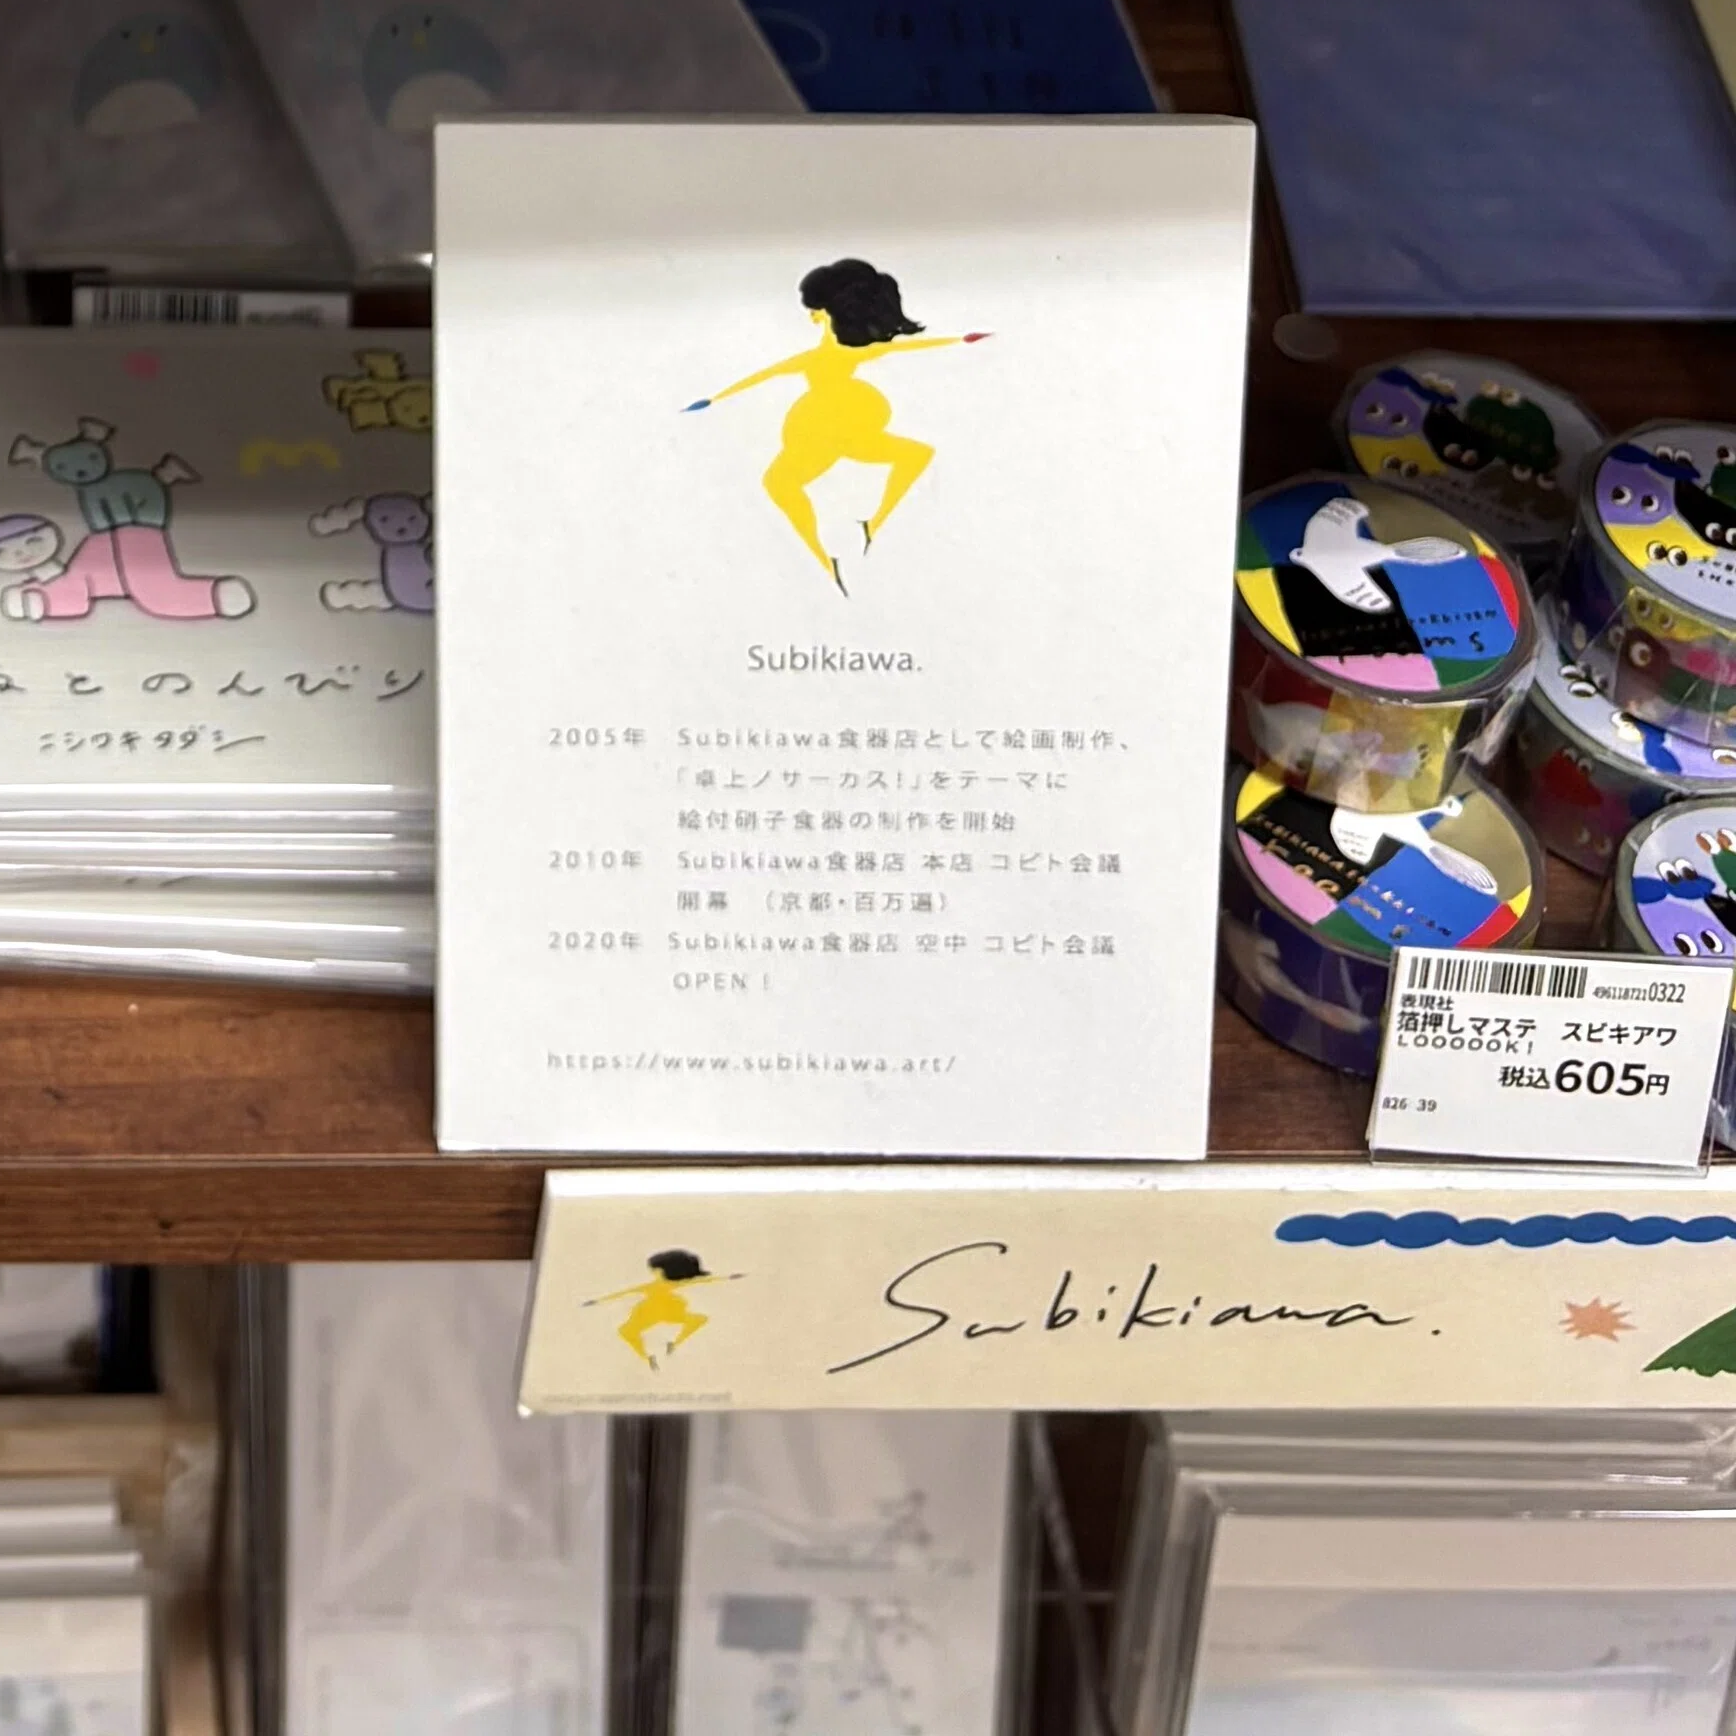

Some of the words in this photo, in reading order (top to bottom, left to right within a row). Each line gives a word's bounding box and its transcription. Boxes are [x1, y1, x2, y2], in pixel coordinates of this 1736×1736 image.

[746, 644, 924, 674] Subikiawa.
[548, 726, 646, 749] 2005年
[548, 849, 644, 871] 2010年
[548, 931, 642, 953] 2020年
[1396, 1010, 1538, 1038] 箔押しマステ
[1561, 1020, 1679, 1047] スビキアワ
[1497, 1058, 1671, 1097] 税込605円
